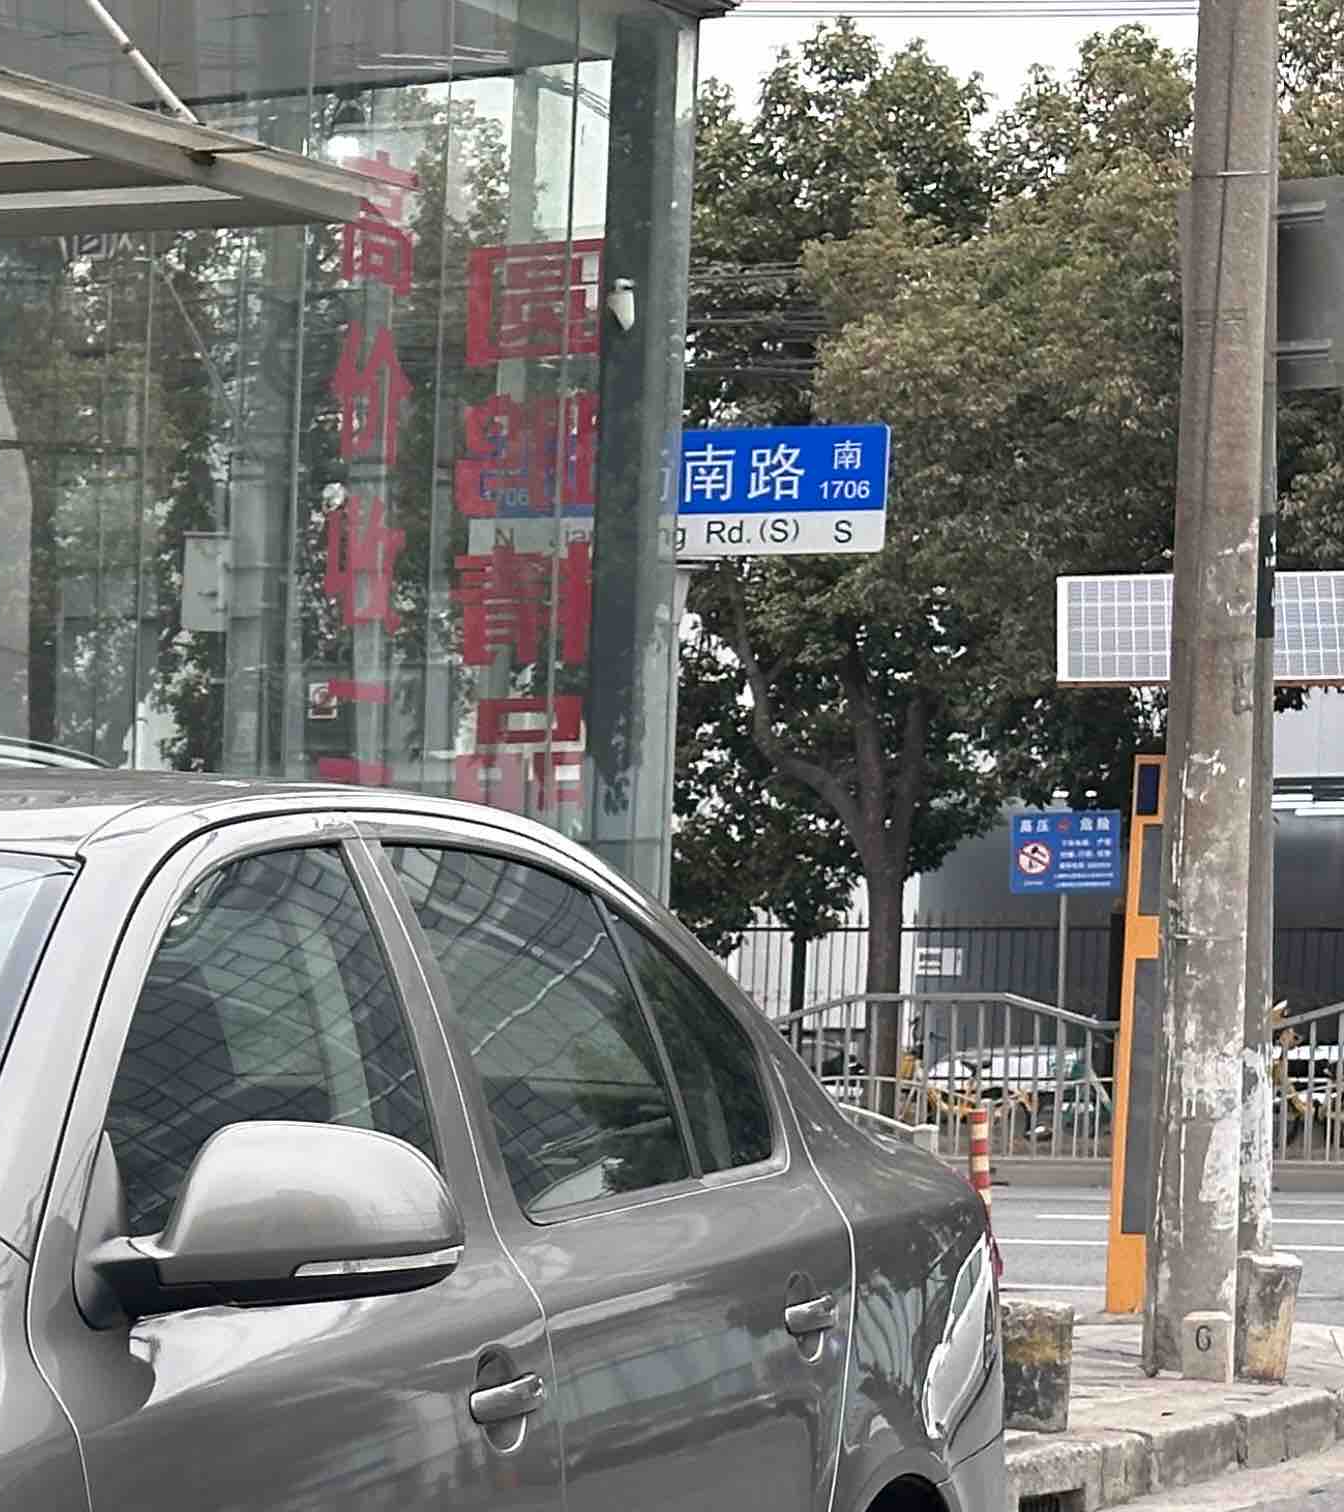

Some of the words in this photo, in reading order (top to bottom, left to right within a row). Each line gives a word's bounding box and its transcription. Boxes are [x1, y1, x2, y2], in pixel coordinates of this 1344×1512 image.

[833, 440, 863, 470] 南
[684, 443, 805, 503] 南路
[819, 480, 870, 500] 1706
[833, 520, 853, 543] S
